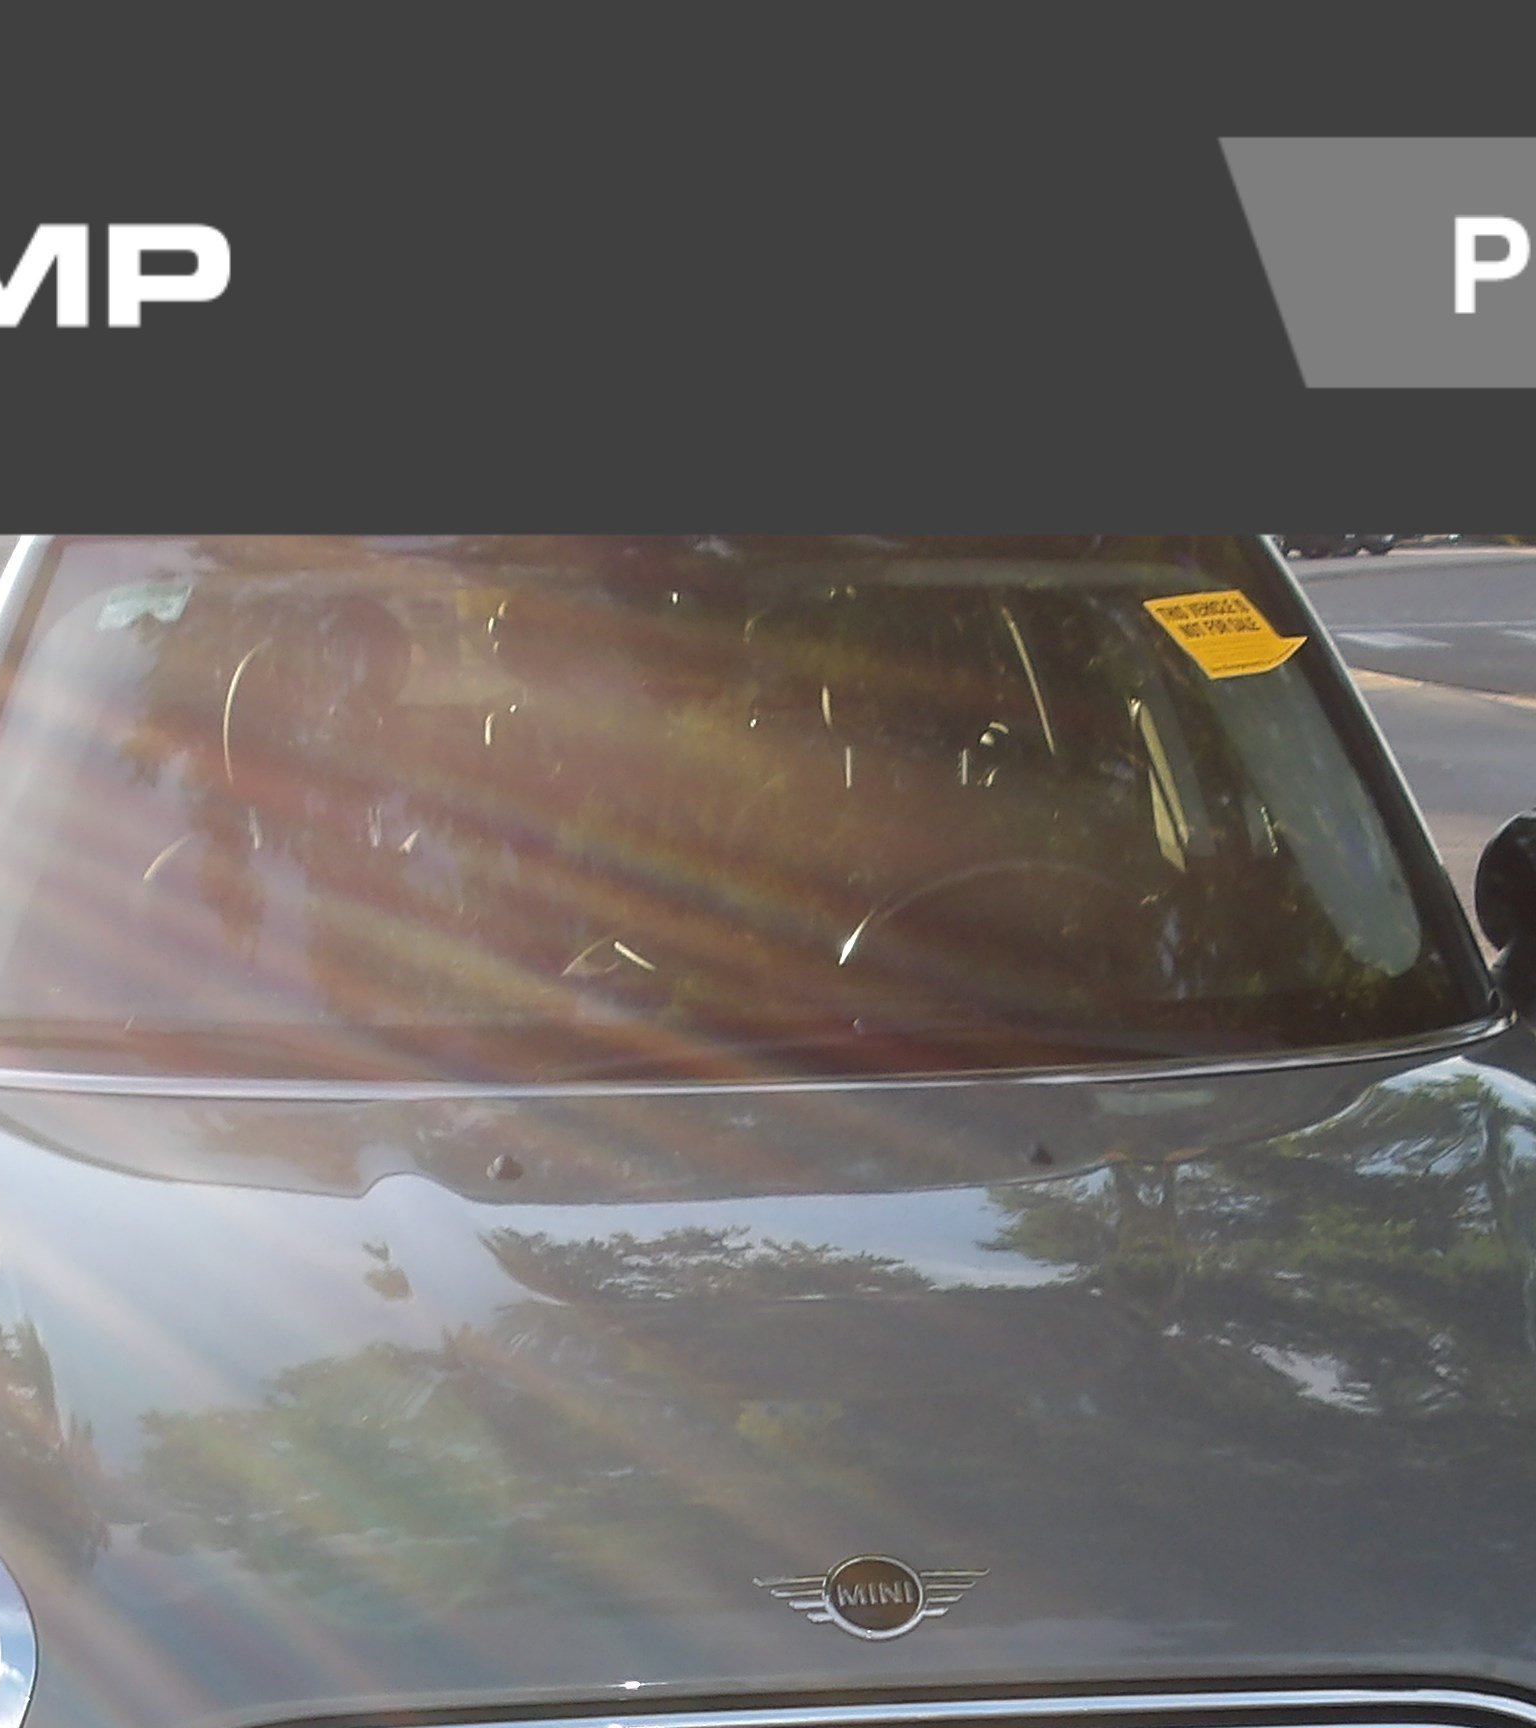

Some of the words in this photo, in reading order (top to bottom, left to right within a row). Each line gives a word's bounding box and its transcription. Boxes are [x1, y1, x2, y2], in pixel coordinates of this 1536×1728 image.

[1179, 621, 1204, 638] NOT
[1203, 619, 1228, 635] FOR
[1228, 617, 1260, 632] SALE
[836, 1579, 915, 1607] MINI
